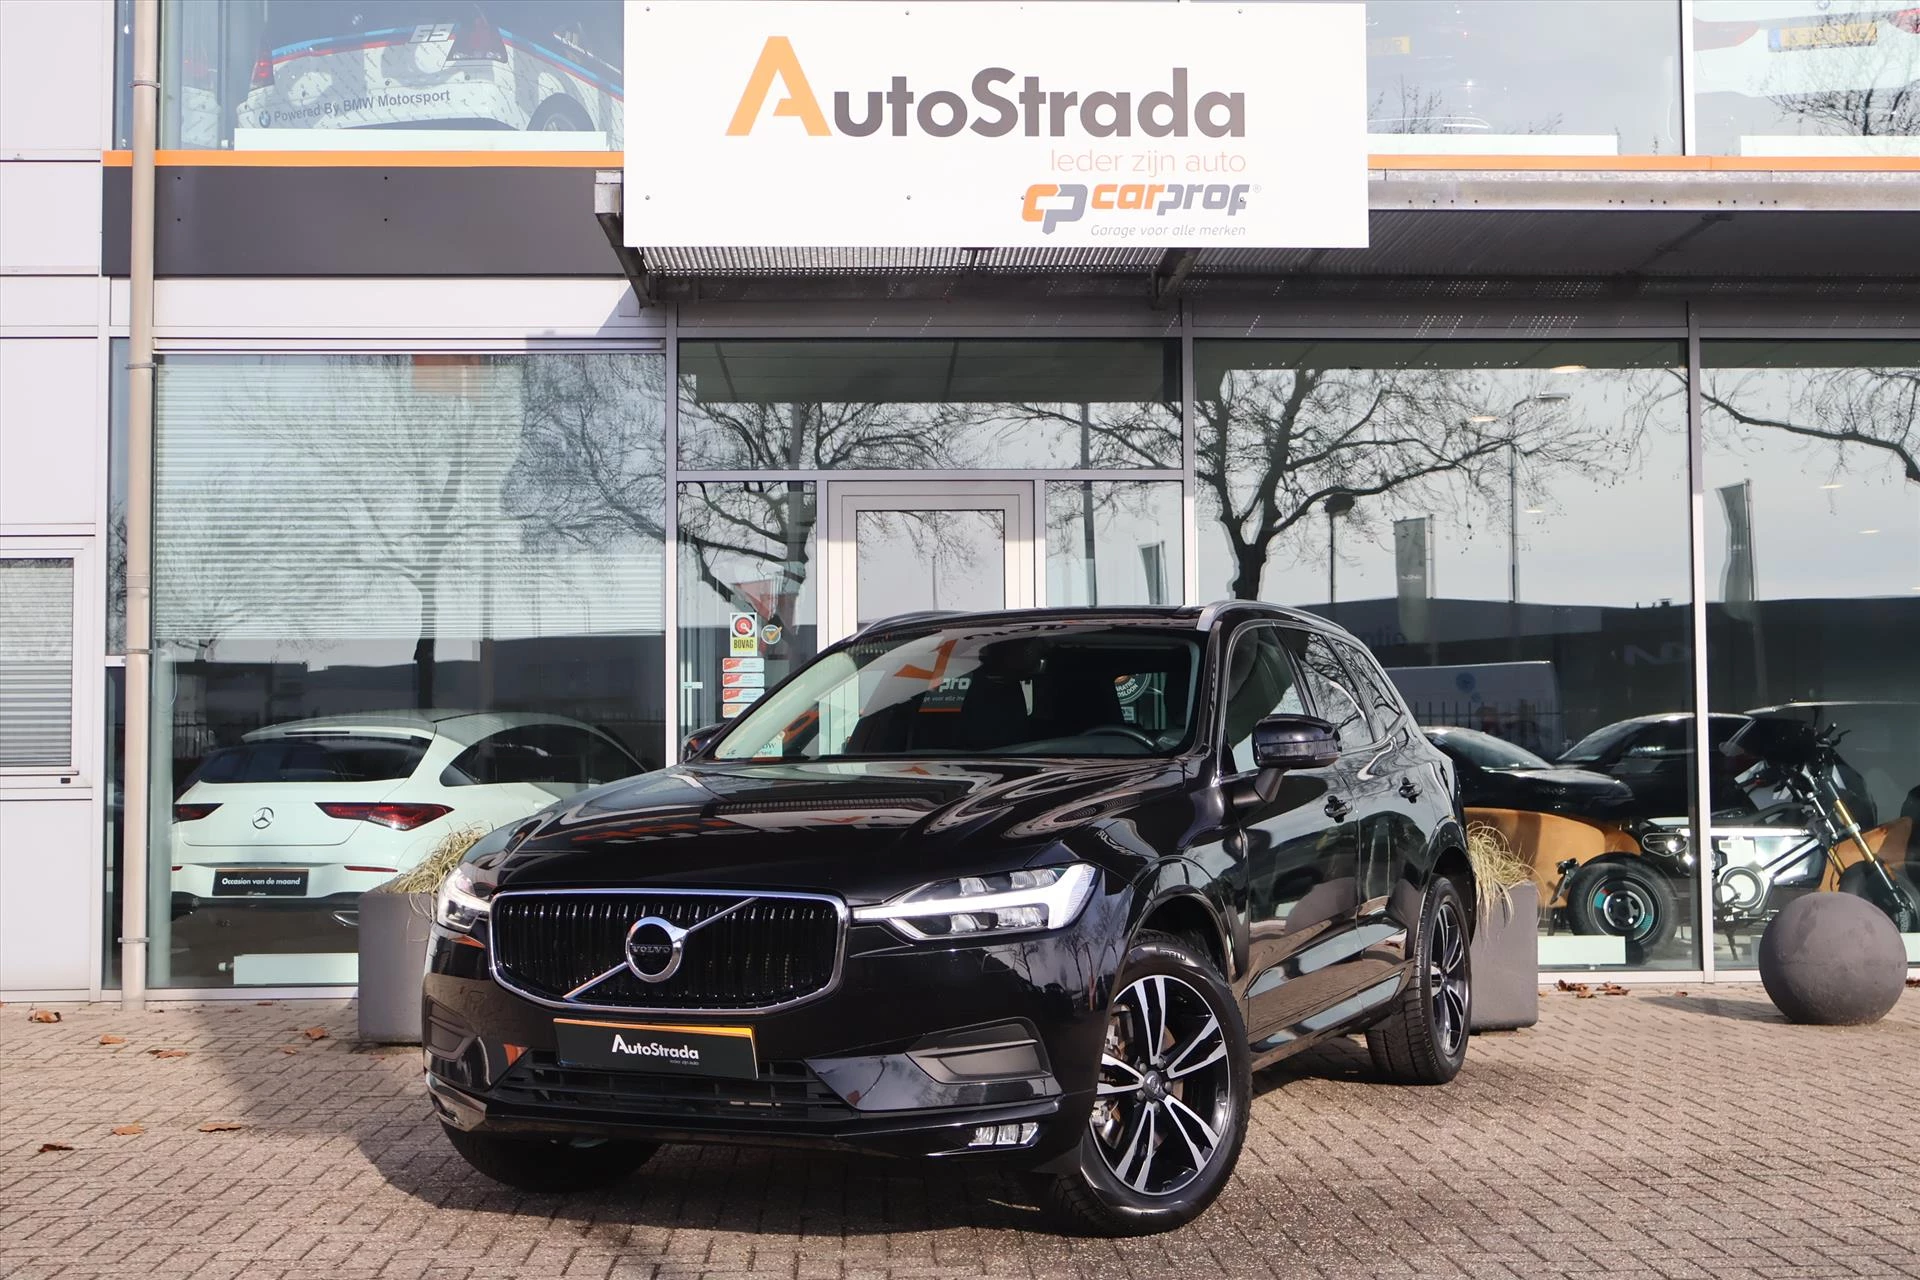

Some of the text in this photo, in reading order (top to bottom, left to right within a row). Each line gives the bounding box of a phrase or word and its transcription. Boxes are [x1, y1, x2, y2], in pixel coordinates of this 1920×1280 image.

[725, 35, 1246, 139] AutoStrada
[274, 90, 451, 122] Powered By BMW Motorsport
[1051, 149, 1247, 178] Ieder zijn auto
[1091, 224, 1246, 238] Garage voor alle merken
[733, 639, 754, 649] BOVAG
[222, 877, 251, 885] Occasion
[266, 877, 274, 885] de
[275, 877, 301, 885] maand
[632, 945, 671, 953] VOLVO
[612, 1034, 700, 1060] AutoStrada
